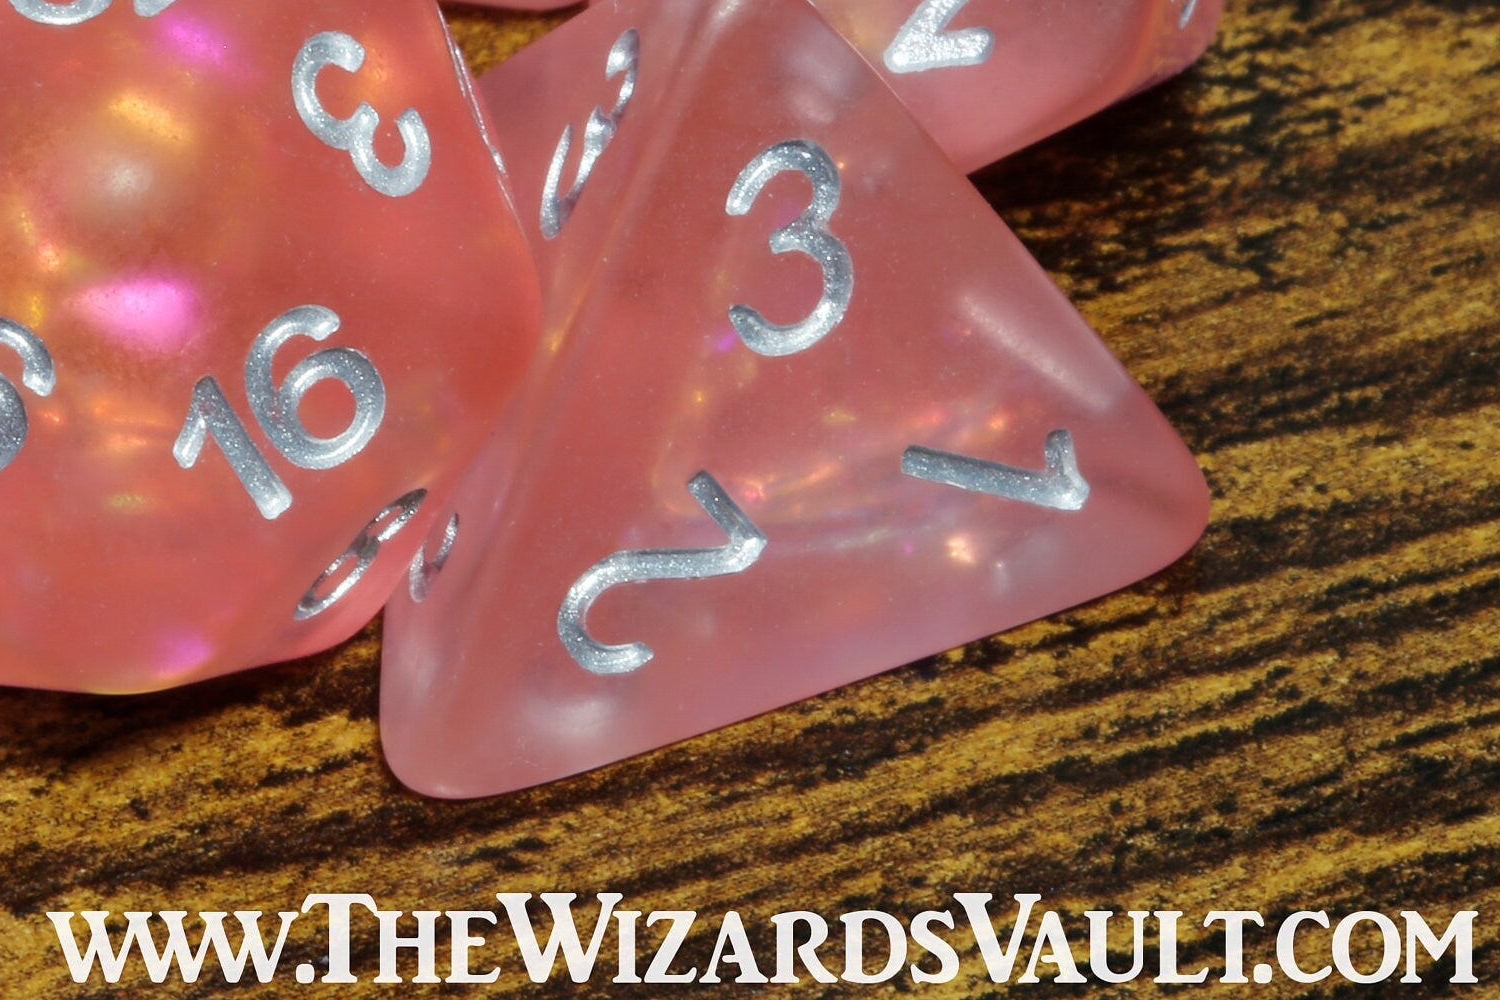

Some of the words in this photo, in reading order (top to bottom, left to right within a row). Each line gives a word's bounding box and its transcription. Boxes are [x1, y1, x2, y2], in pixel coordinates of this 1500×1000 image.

[292, 30, 432, 198] 3
[540, 27, 641, 240] 3
[726, 138, 854, 357] 3
[172, 305, 386, 520] 16
[902, 428, 1090, 511] 1
[293, 488, 428, 621] 8
[557, 470, 767, 674] 2
